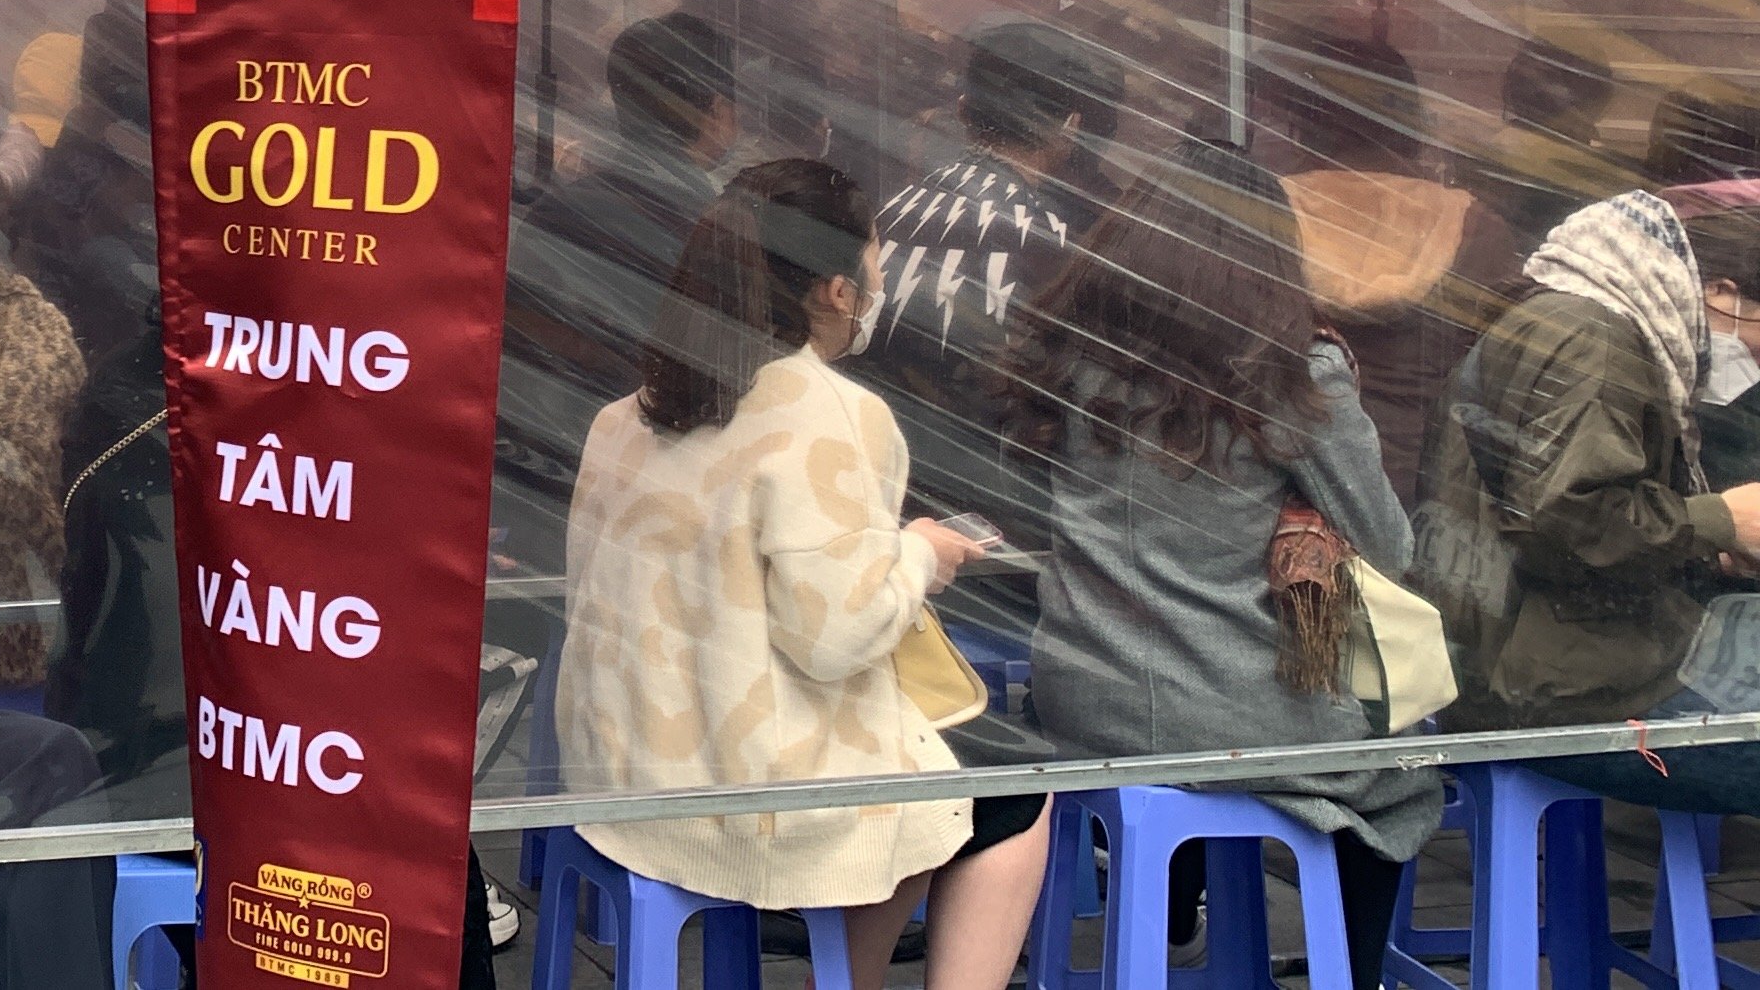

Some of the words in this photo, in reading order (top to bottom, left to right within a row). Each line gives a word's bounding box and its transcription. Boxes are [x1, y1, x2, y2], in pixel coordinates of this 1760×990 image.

[235, 60, 372, 107] BTMC
[190, 120, 440, 214] GOLD
[223, 224, 379, 266] CENTER
[204, 311, 411, 392] TRUNG
[216, 433, 354, 522] TÂM
[197, 558, 382, 659] VÀNG
[198, 695, 366, 795] BTMC
[261, 869, 303, 892] VÀNG
[307, 876, 353, 901] RỒNG
[232, 897, 310, 938] THĂNG
[316, 918, 384, 951] LONG
[256, 932, 279, 950] FINE
[283, 936, 312, 956] GOLD
[259, 956, 295, 976] BTMC
[306, 968, 342, 985] 1989
